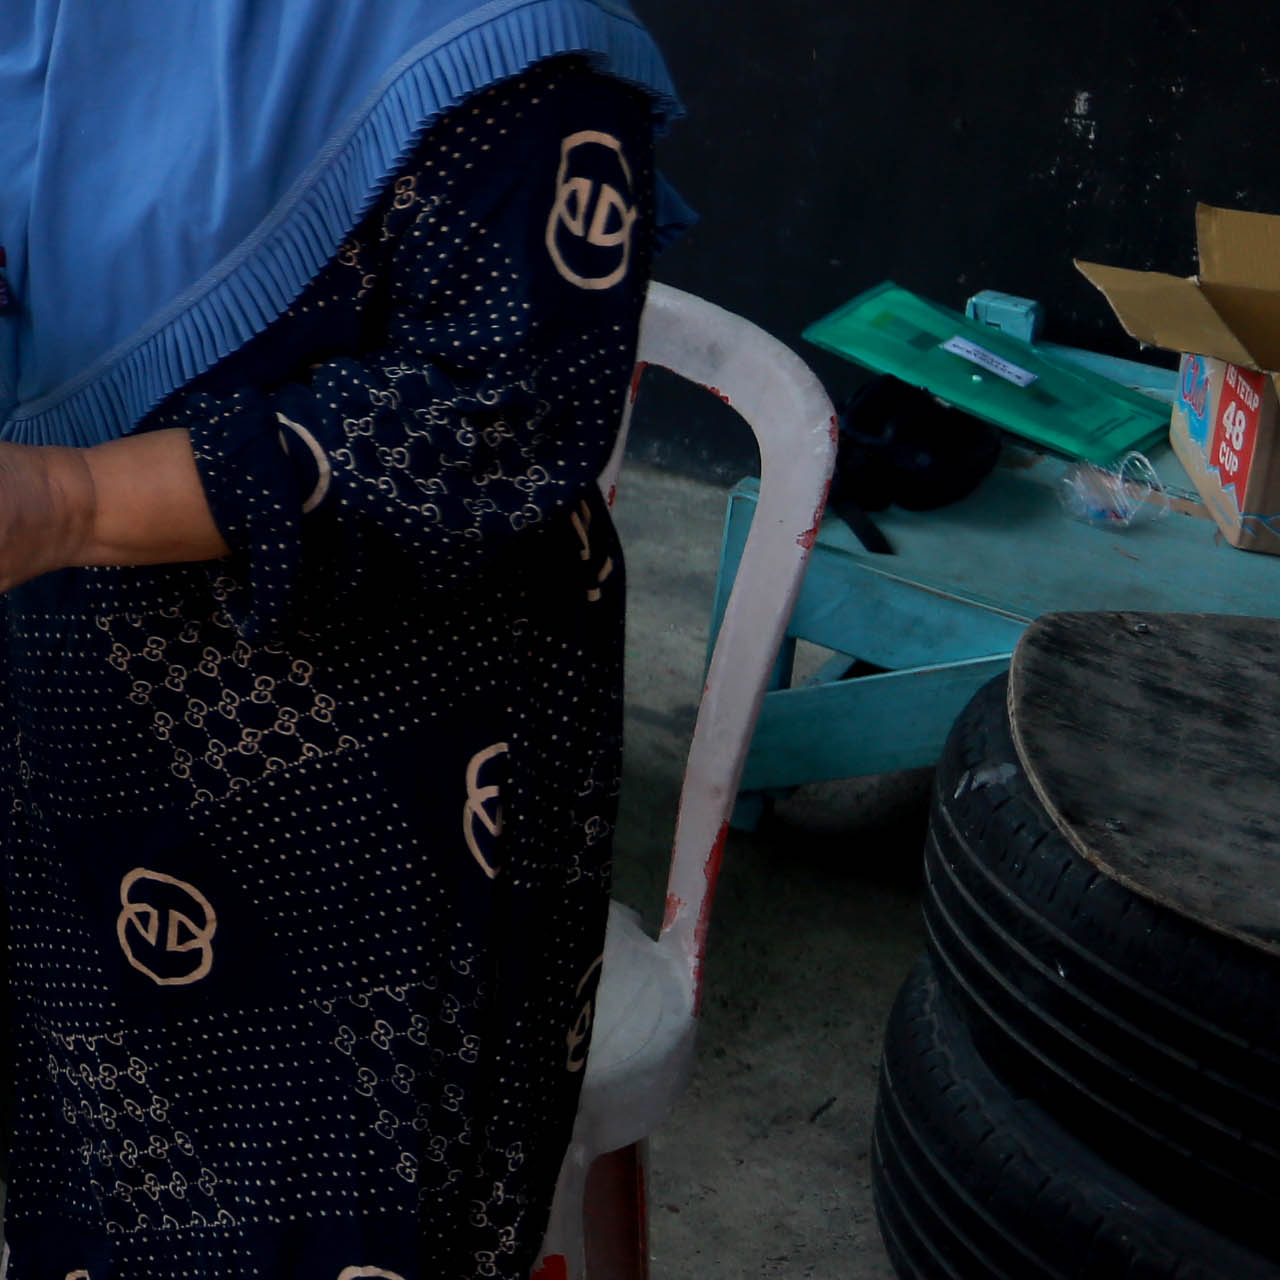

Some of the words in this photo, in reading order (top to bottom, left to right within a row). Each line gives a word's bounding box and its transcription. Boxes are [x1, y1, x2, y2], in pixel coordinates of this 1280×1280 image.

[1237, 375, 1260, 413] TETAP
[1223, 400, 1246, 451] 48
[1219, 440, 1239, 476] CUP
